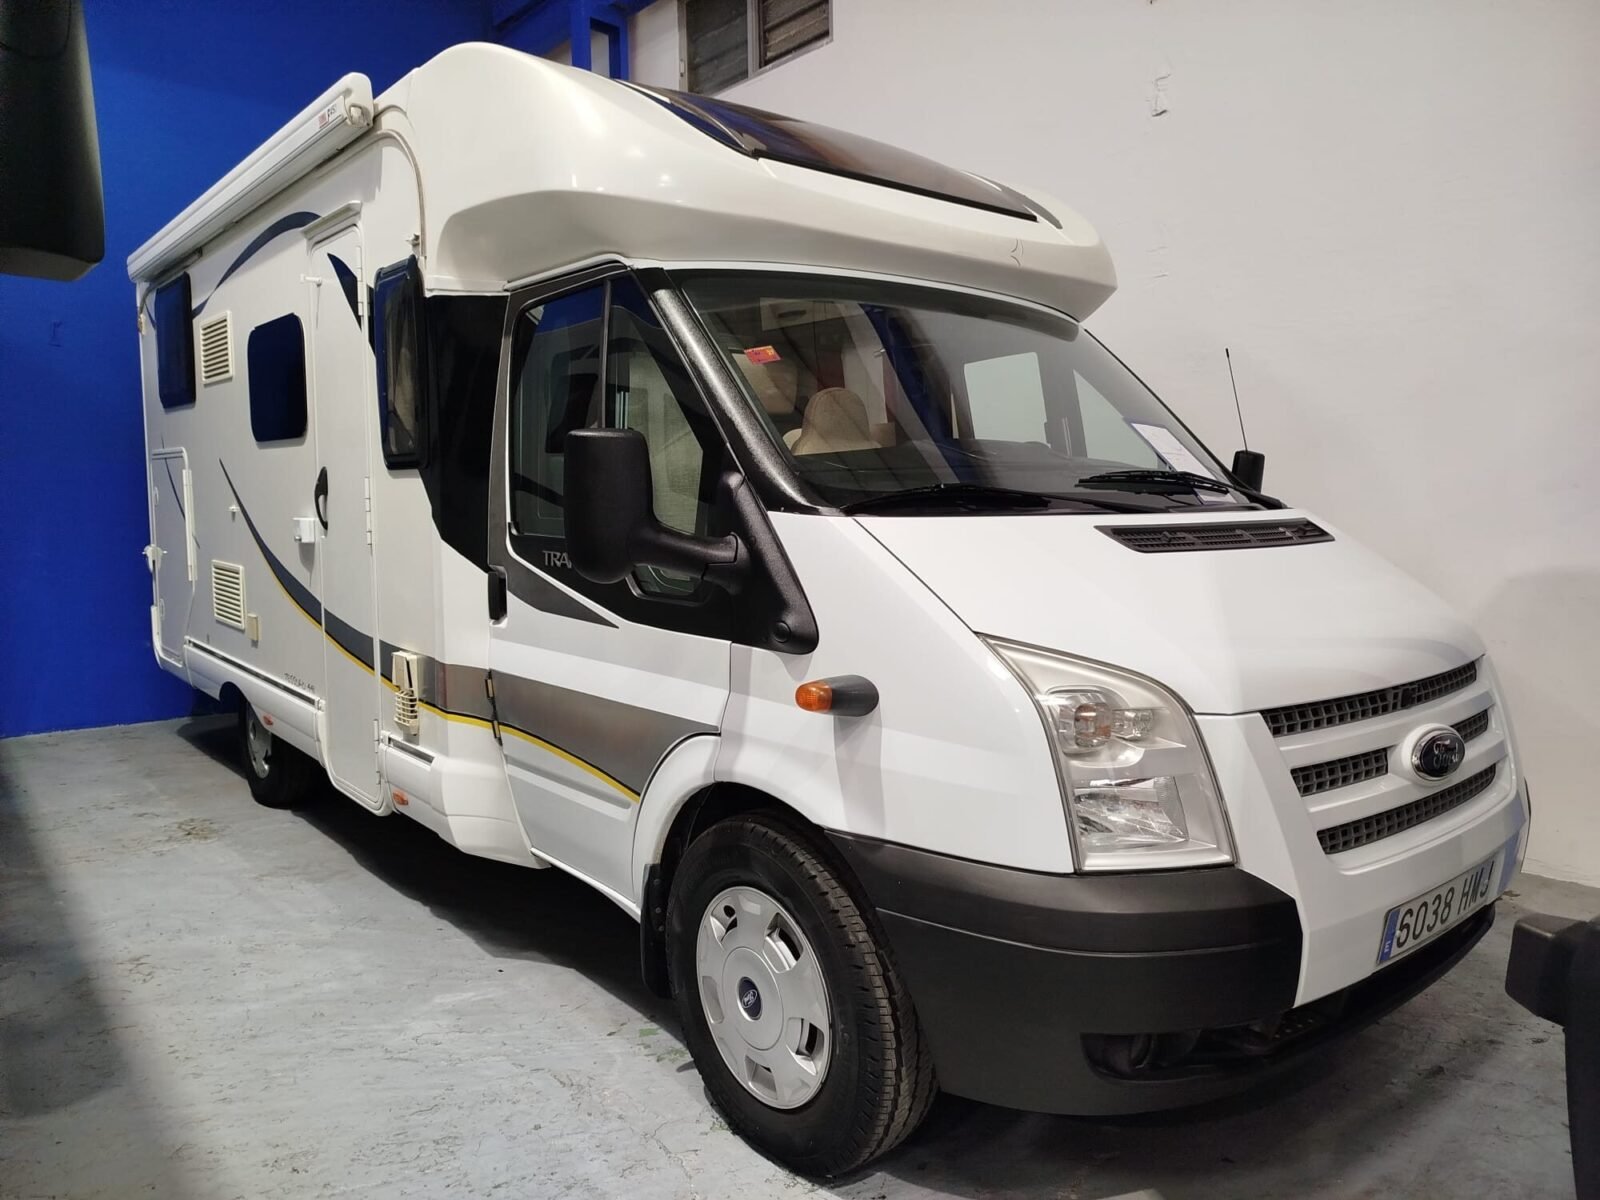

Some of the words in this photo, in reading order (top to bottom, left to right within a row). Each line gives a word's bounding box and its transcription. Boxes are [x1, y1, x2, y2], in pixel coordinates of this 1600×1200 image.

[1433, 739, 1459, 769] Ford
[1396, 886, 1455, 948] 6038
[1457, 860, 1494, 915] HMJ
